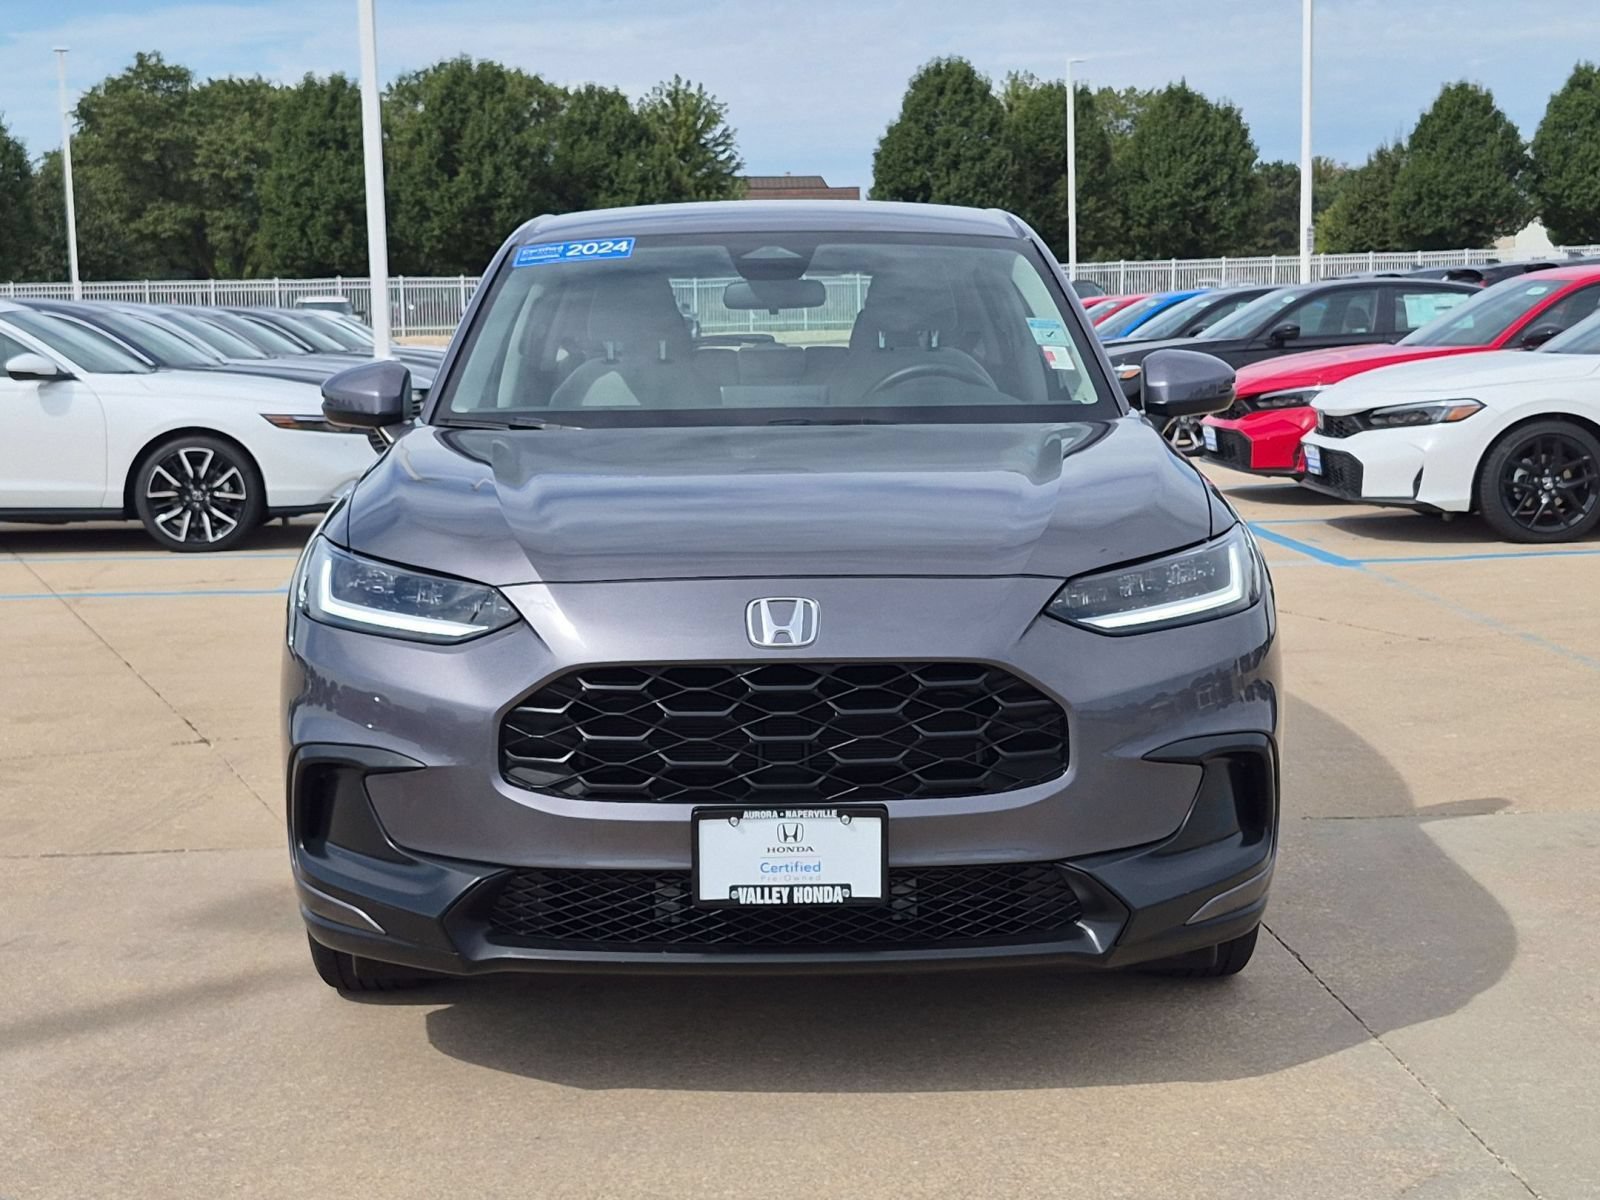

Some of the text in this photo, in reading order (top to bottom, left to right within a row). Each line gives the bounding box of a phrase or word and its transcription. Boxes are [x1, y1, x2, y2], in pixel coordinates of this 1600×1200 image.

[566, 240, 628, 257] 2024
[742, 809, 838, 819] AURORA NAPERVILLE
[760, 861, 821, 873] Certified
[737, 885, 844, 905] VALLEY HONDA
